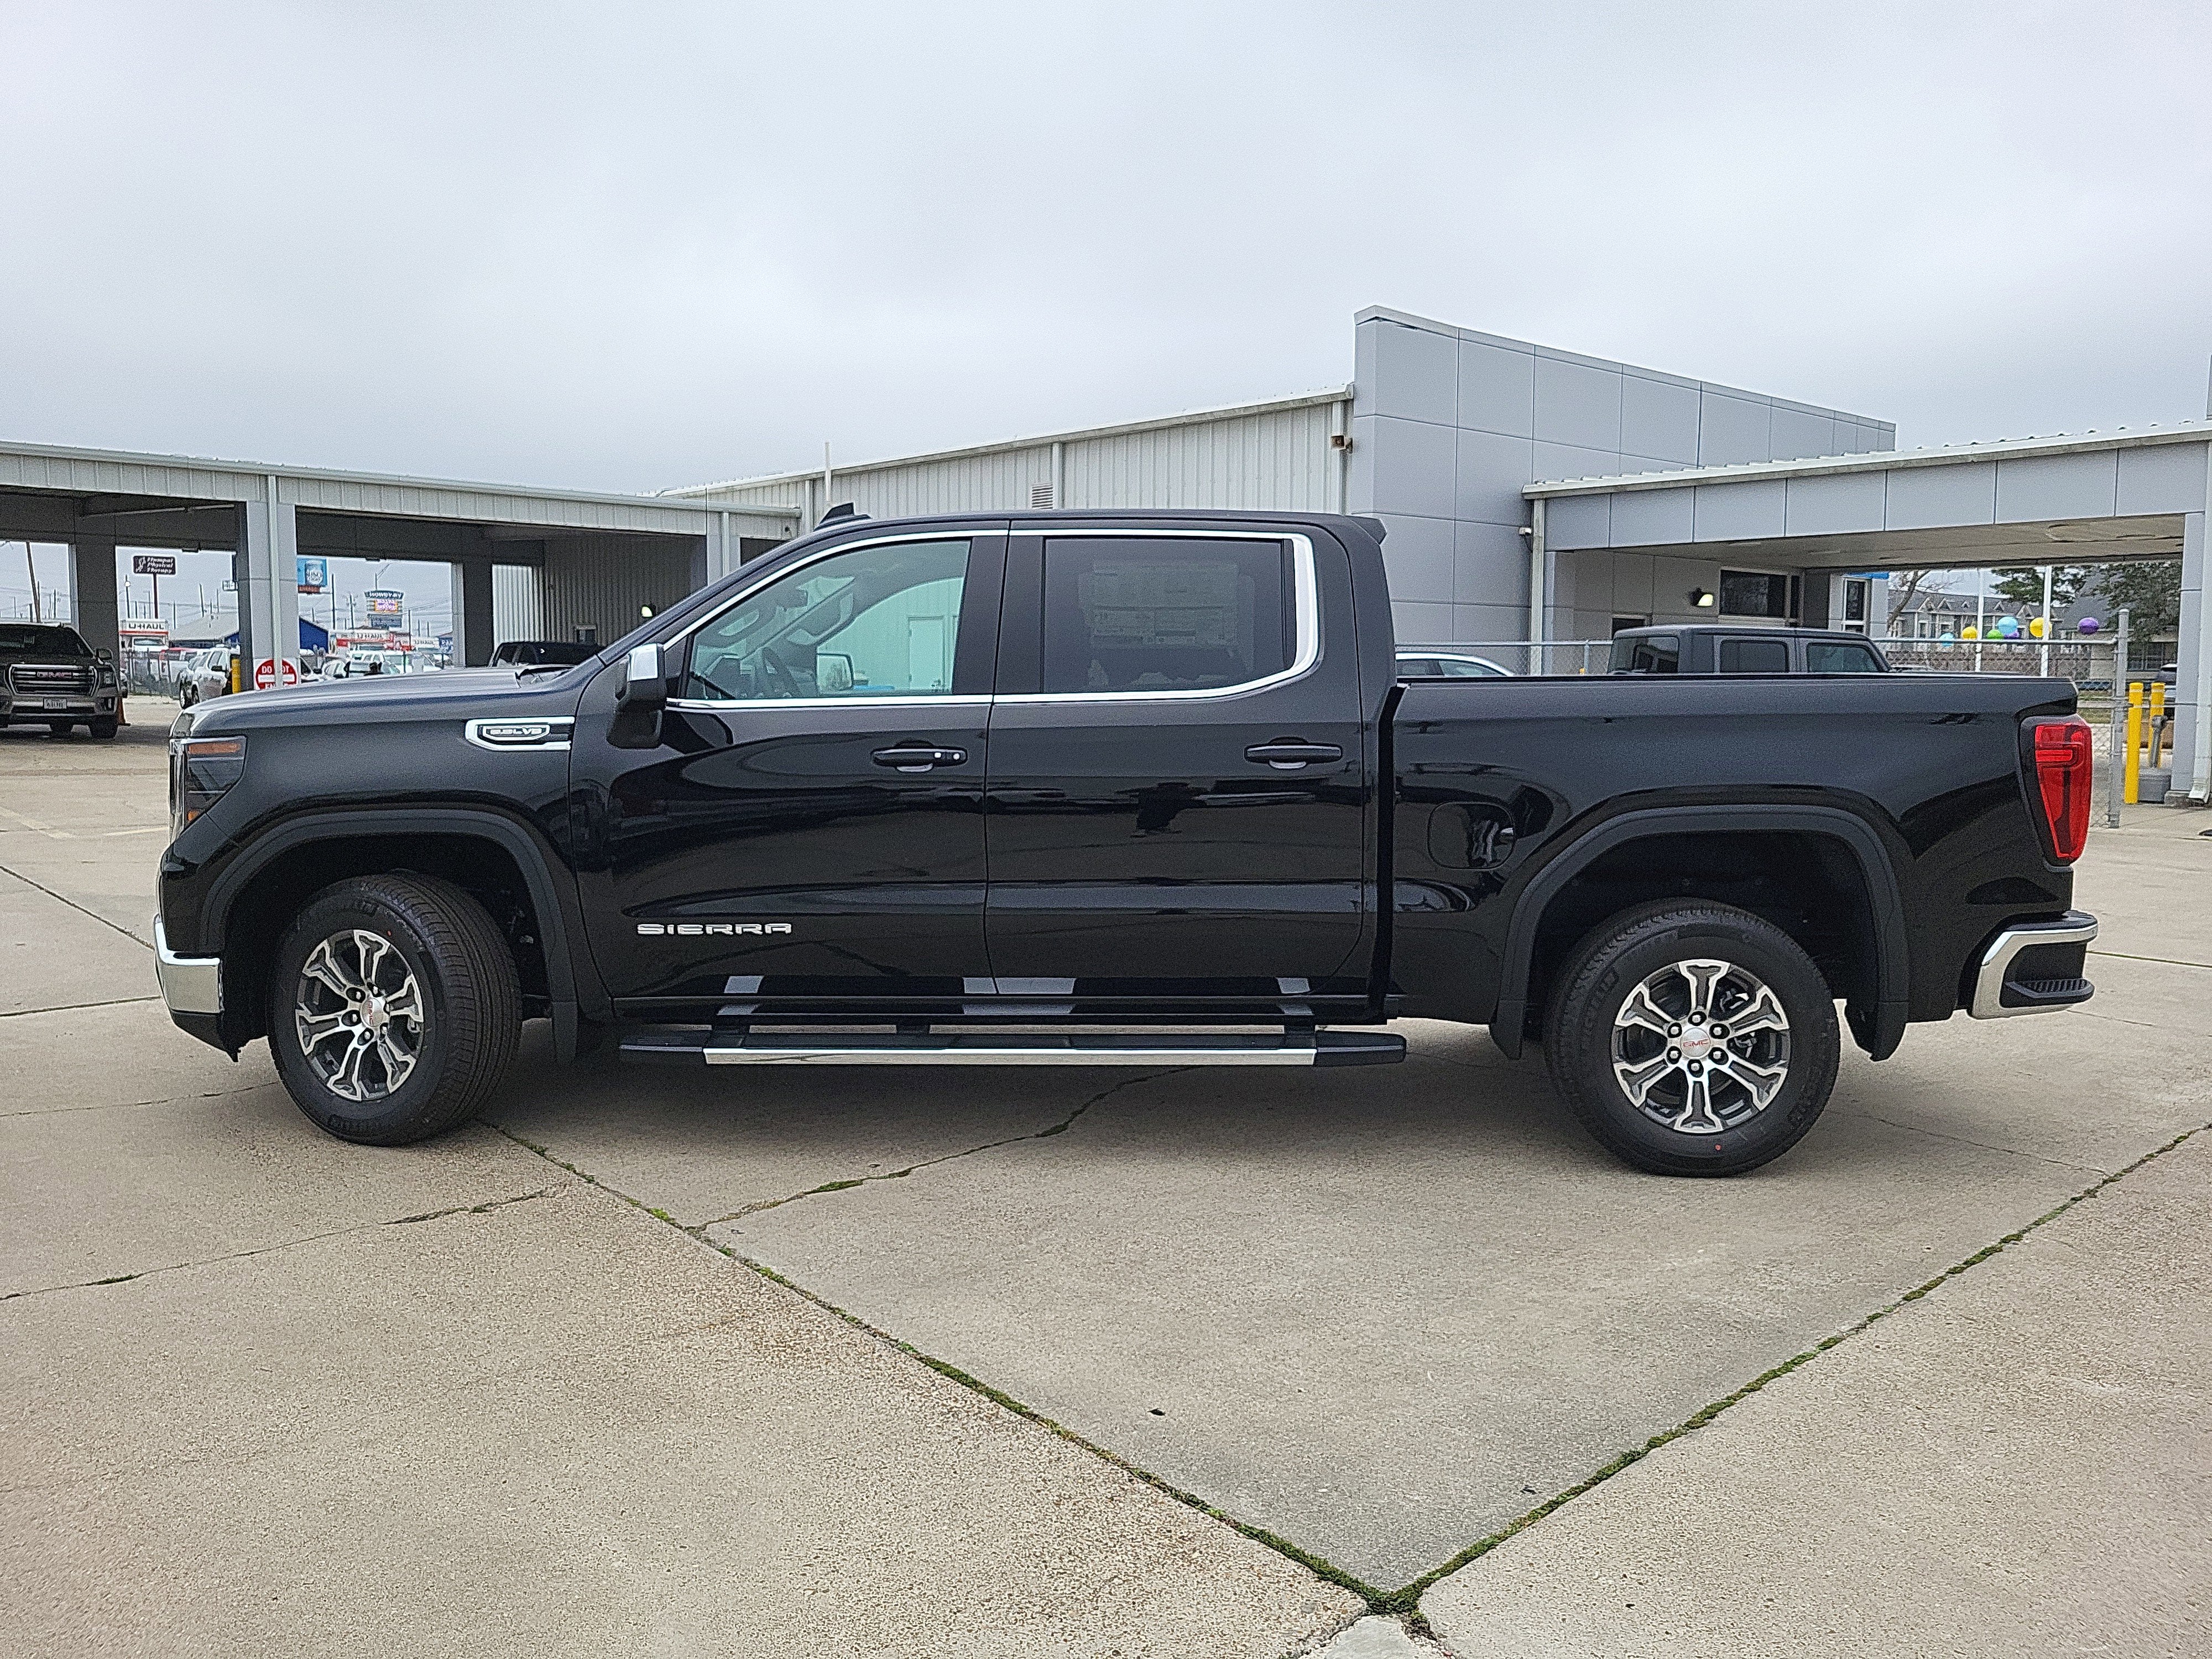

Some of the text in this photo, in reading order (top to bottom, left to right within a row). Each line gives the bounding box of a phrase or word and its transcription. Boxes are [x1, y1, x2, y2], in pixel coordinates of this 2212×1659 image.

[262, 665, 273, 674] DO
[637, 923, 792, 935] SIERRA
[1683, 1038, 1710, 1047] GMC
